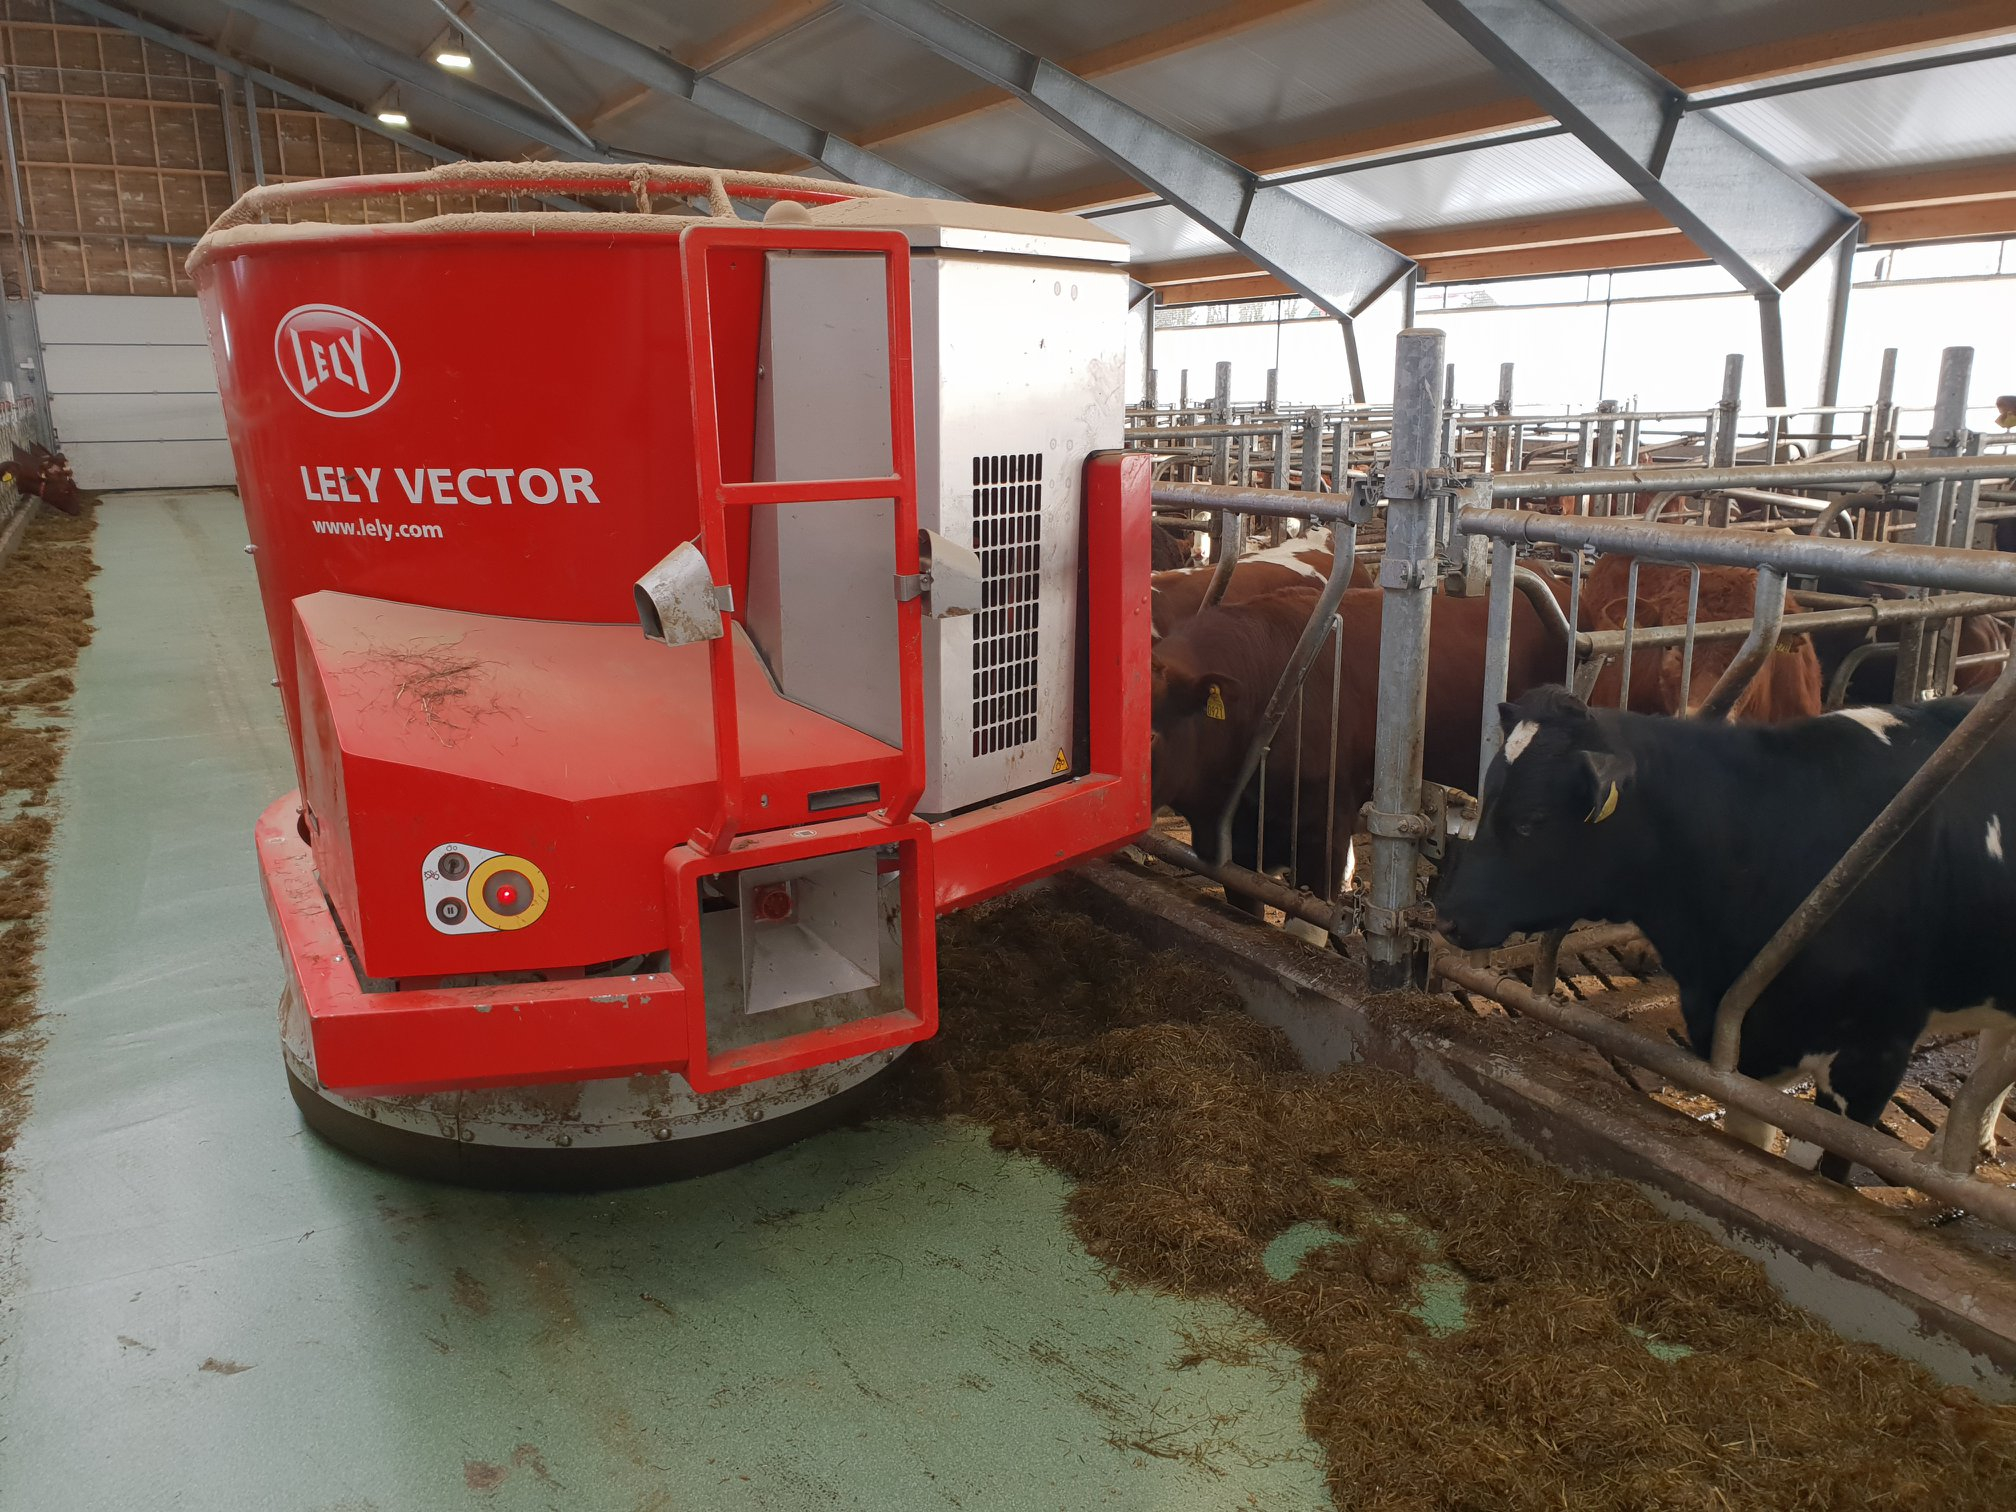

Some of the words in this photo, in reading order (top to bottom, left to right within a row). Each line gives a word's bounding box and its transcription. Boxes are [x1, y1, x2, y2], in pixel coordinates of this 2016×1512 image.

[290, 326, 370, 395] LELY
[300, 465, 381, 503] LELY
[394, 467, 600, 505] VECTOR
[312, 518, 443, 541] www.lely.com
